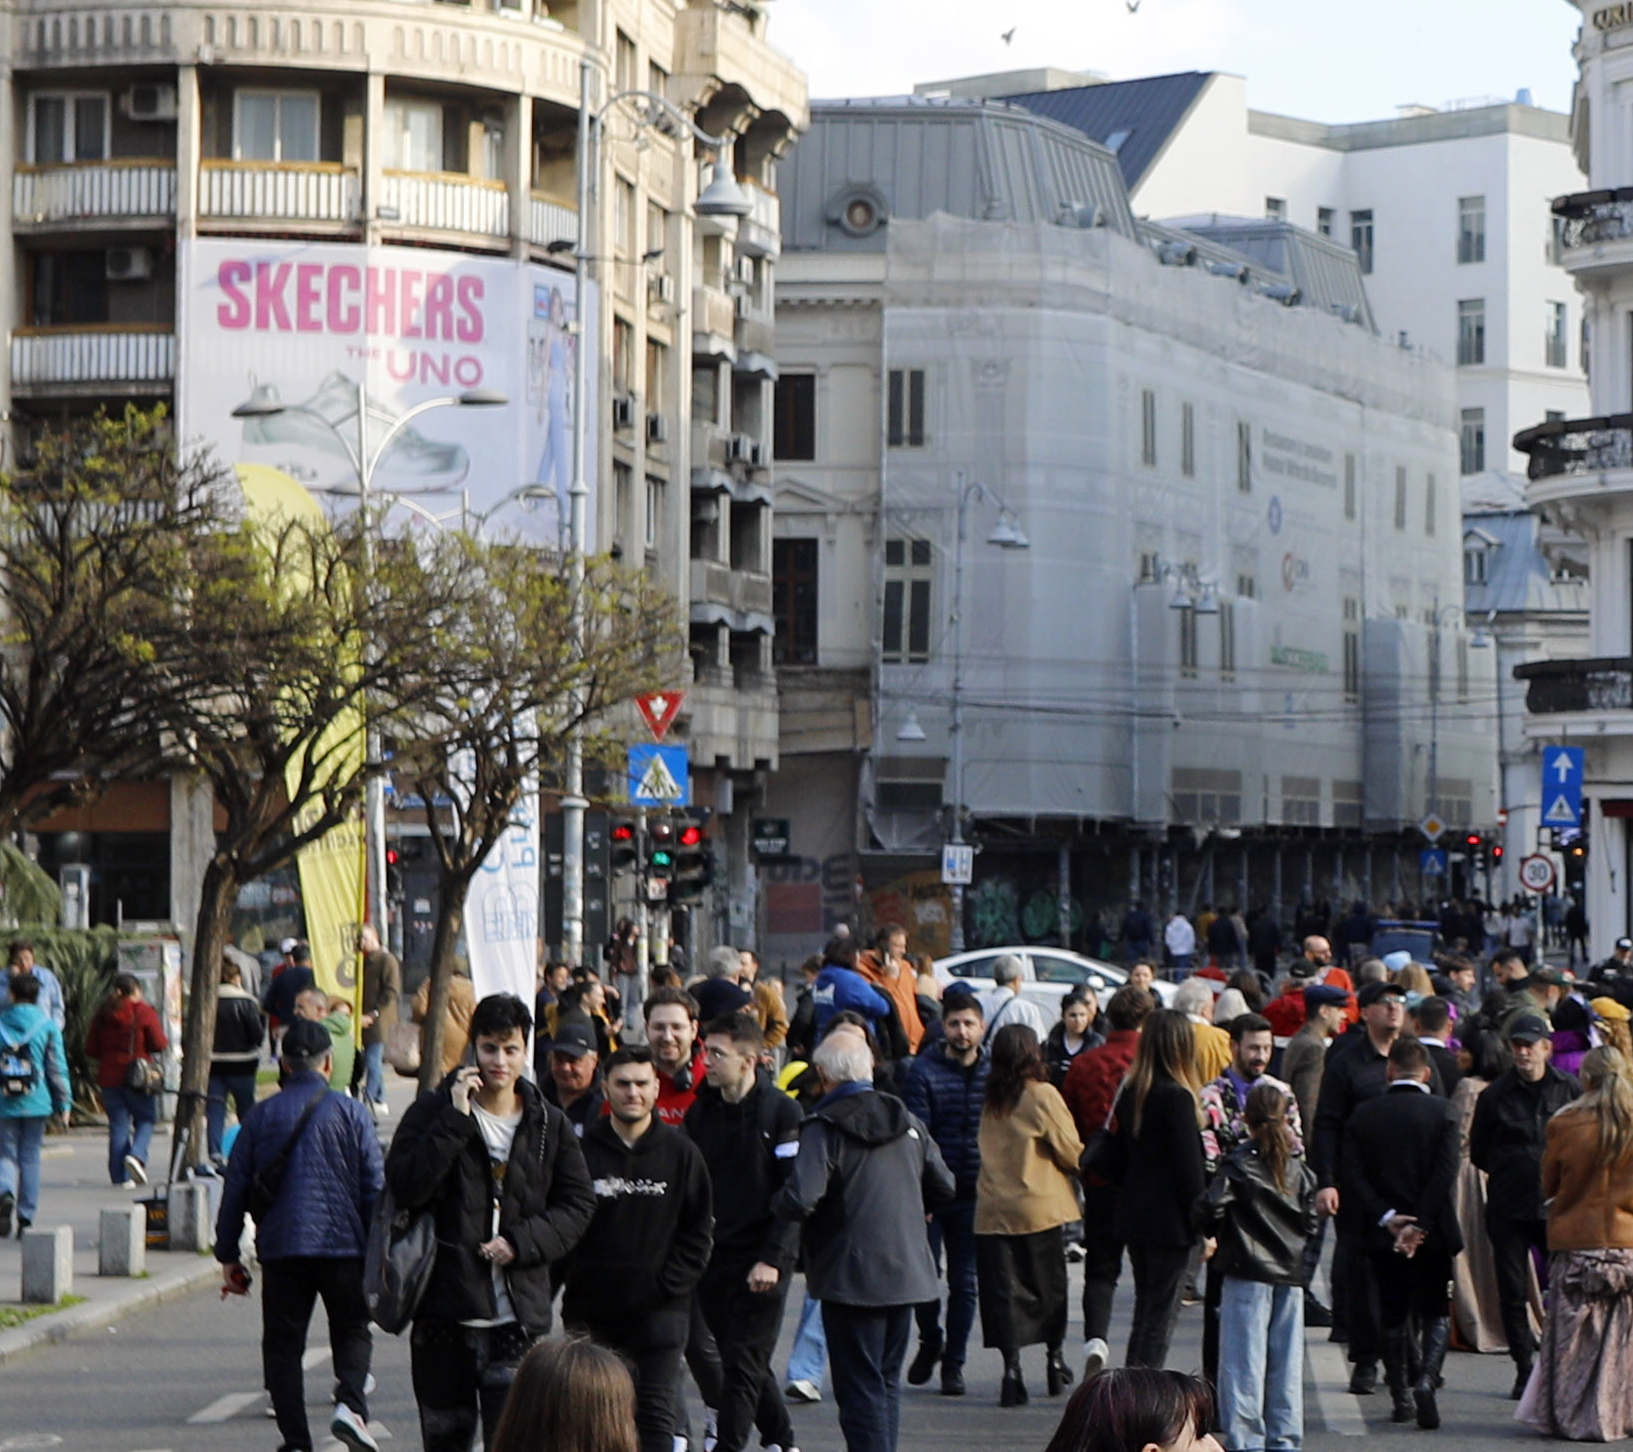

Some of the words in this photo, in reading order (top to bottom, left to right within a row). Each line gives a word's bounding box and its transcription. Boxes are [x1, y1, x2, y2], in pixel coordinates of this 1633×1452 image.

[217, 260, 485, 345] SKECHERS
[387, 350, 483, 388] UNO
[1528, 864, 1547, 881] 30
